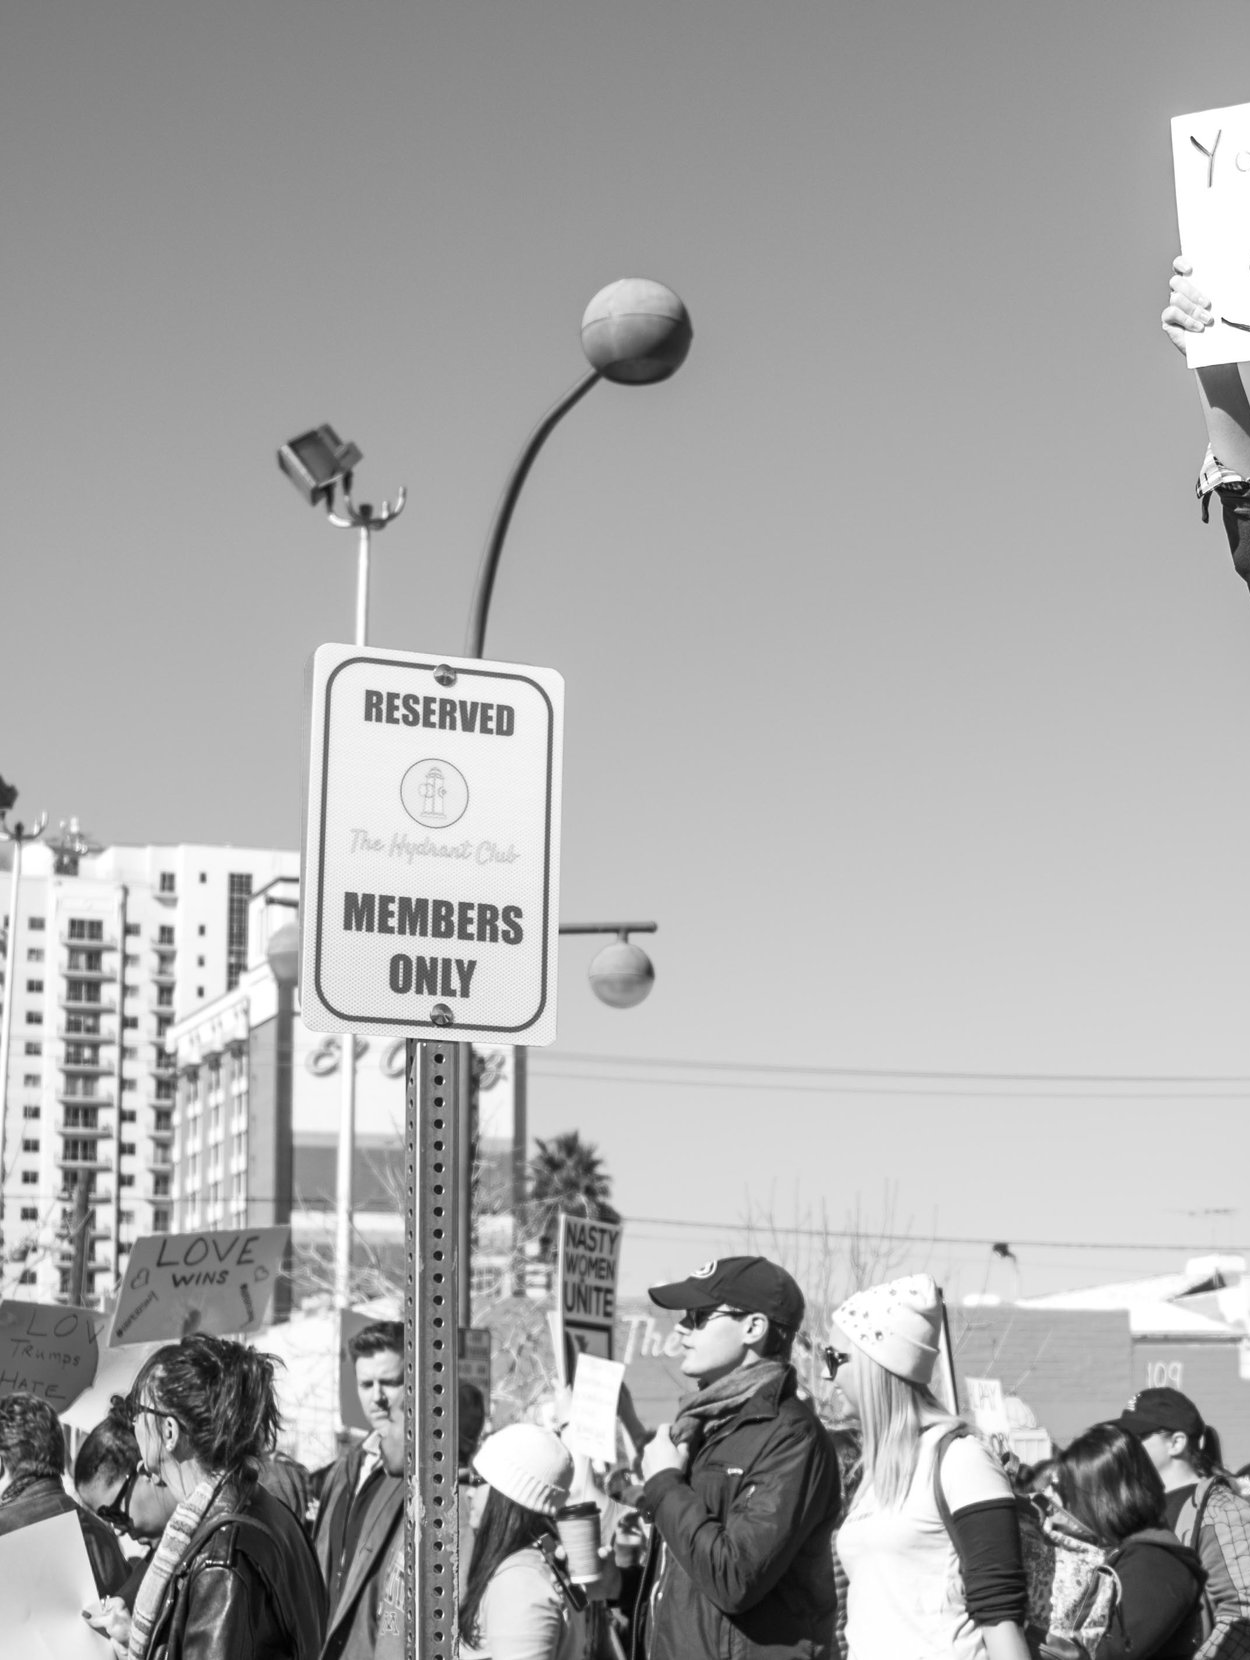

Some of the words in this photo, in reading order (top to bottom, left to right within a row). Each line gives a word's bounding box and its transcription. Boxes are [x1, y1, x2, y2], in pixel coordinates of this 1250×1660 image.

[363, 688, 515, 737] RESERVED
[350, 828, 386, 854] The
[388, 832, 473, 866] Hydrant
[475, 839, 521, 866] Club
[342, 891, 524, 946] MEMBERS
[388, 953, 478, 999] ONLY
[156, 1236, 261, 1268] LOVE
[566, 1221, 620, 1256] NASTY
[171, 1269, 229, 1288] WINS
[565, 1255, 615, 1282] WOMEN
[564, 1280, 614, 1318] UNITE
[26, 1308, 104, 1345] LOV
[621, 1315, 686, 1365] The
[0, 1369, 66, 1400] HATE
[1147, 1360, 1184, 1389] 109
